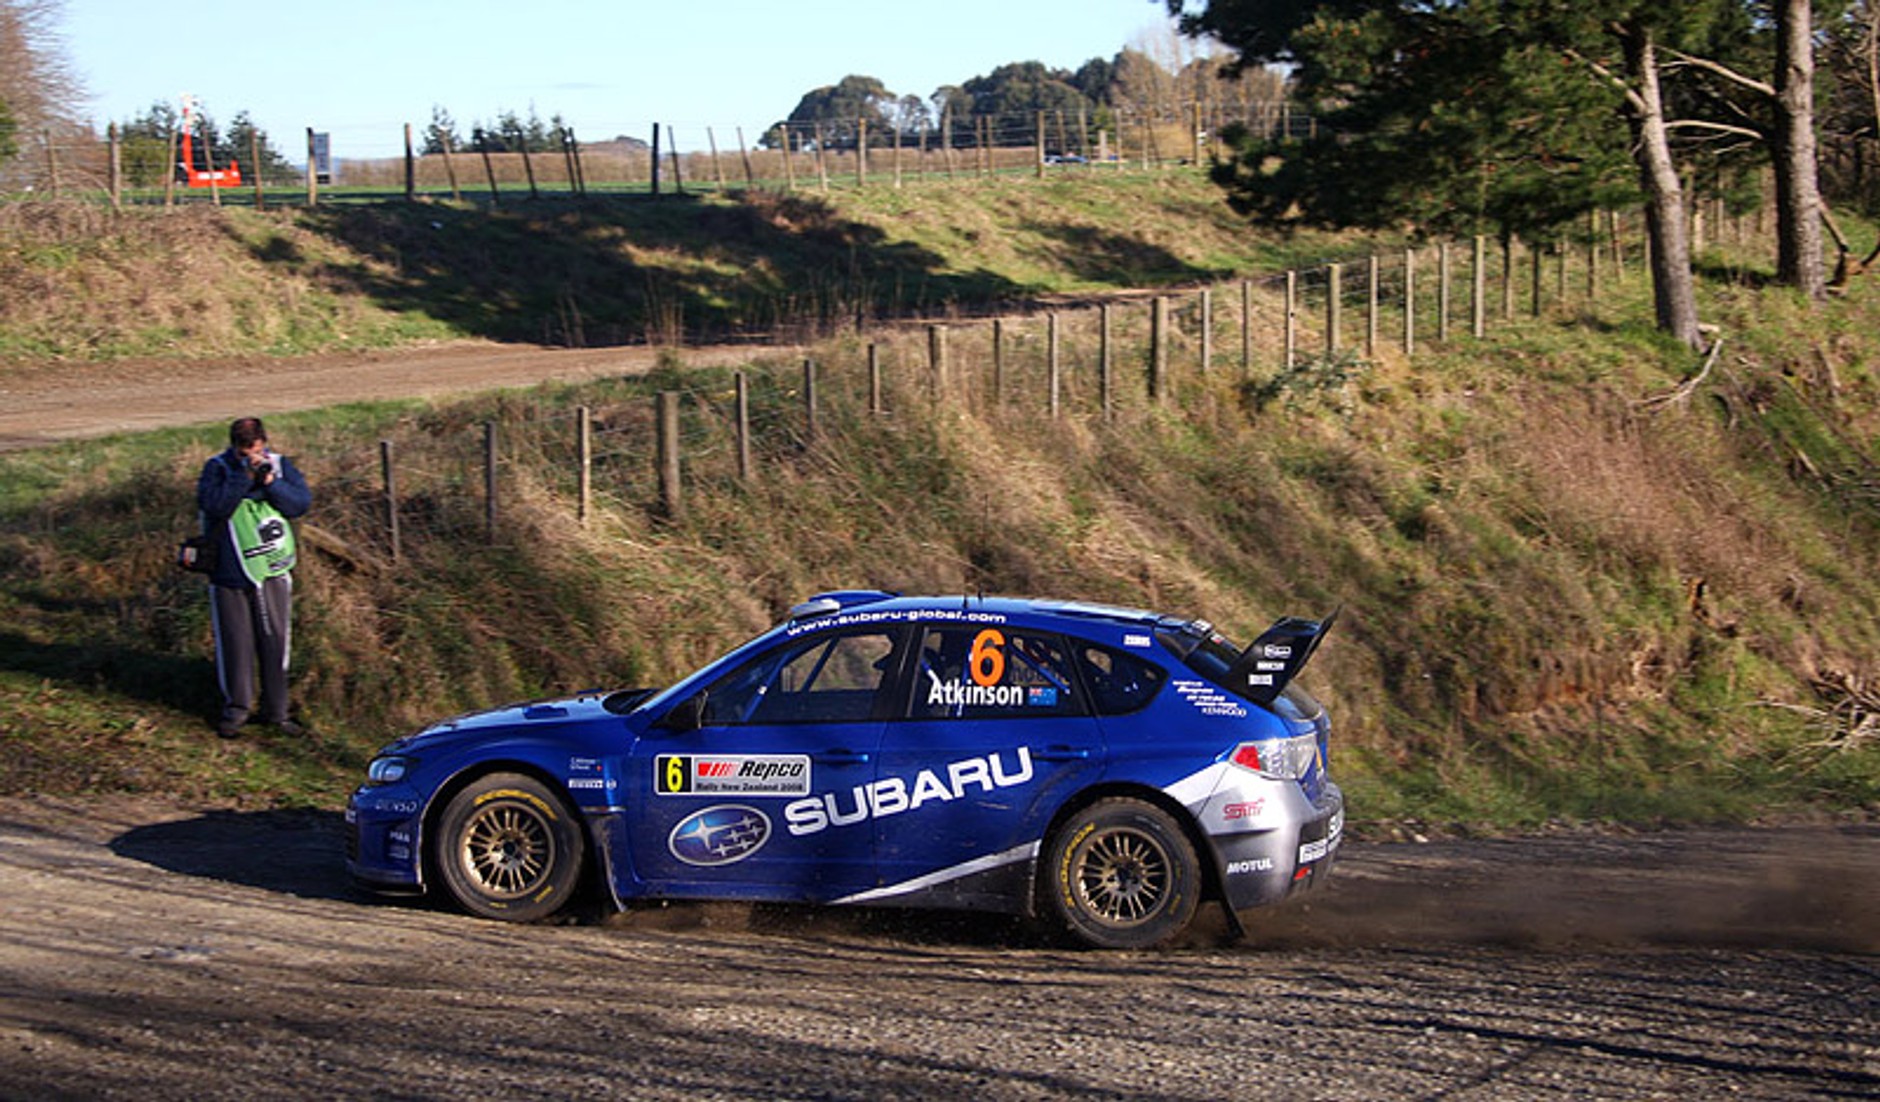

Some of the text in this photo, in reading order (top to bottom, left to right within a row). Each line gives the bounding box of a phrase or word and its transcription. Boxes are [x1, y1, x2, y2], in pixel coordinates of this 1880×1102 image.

[787, 609, 1006, 636] www.subaru-global.com
[971, 628, 1006, 688] 6
[928, 678, 1024, 705] Atkinson
[666, 756, 683, 793] 6
[738, 761, 805, 781] Repco
[696, 783, 718, 792] Rally
[721, 783, 740, 791] New
[742, 782, 779, 792] Zealand
[784, 746, 1034, 837] SUBARU
[1226, 858, 1274, 875] MOTUL
